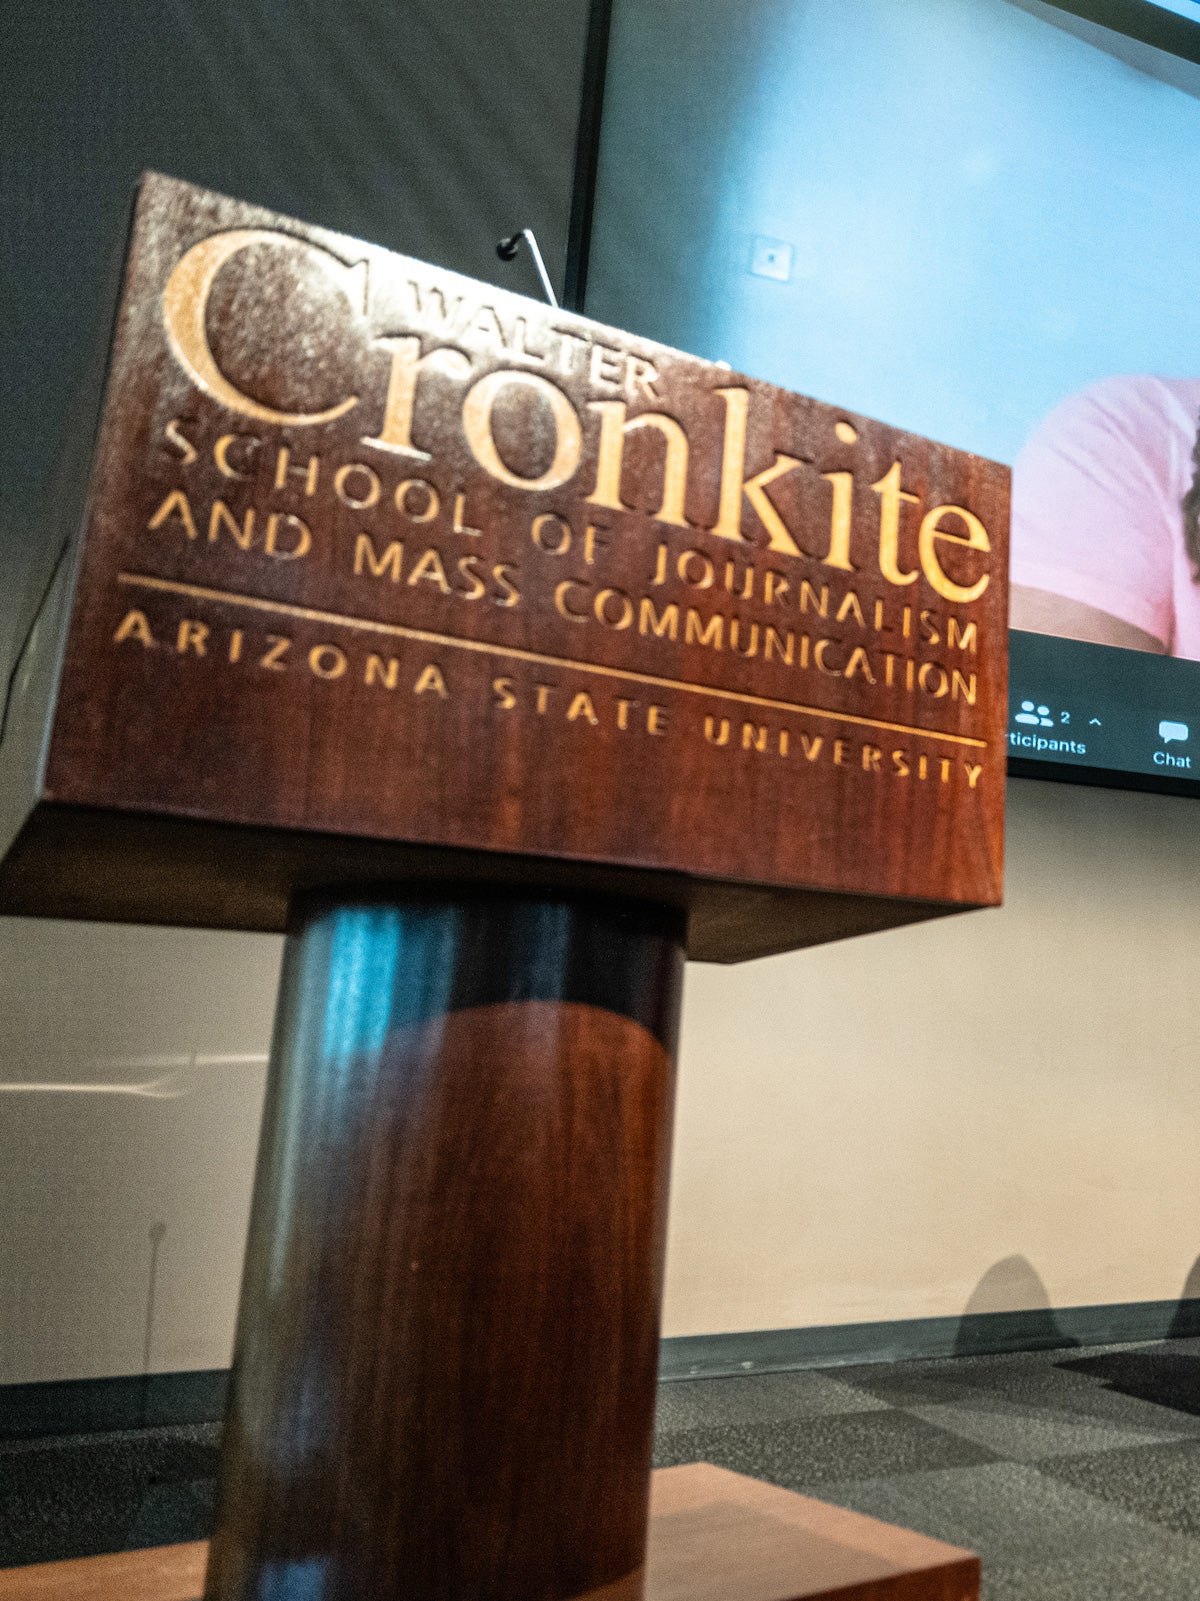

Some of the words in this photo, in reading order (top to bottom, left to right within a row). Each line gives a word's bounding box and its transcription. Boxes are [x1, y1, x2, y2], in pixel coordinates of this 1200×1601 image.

[405, 278, 660, 398] WALTER
[162, 228, 992, 604] Cronkite
[149, 491, 313, 561] AND
[355, 536, 520, 608] MASS
[554, 578, 978, 706] COMMUNICATION
[165, 420, 482, 537] SCHOOL
[531, 513, 608, 566] OF
[652, 544, 979, 655] JOURNALISM
[113, 610, 450, 699] ARIZONA
[494, 676, 671, 736] STATE
[705, 715, 984, 789] UNIVERSITY
[1005, 732, 1087, 755] ticipants
[1060, 711, 1070, 724] 2
[1153, 751, 1191, 769] Chat
